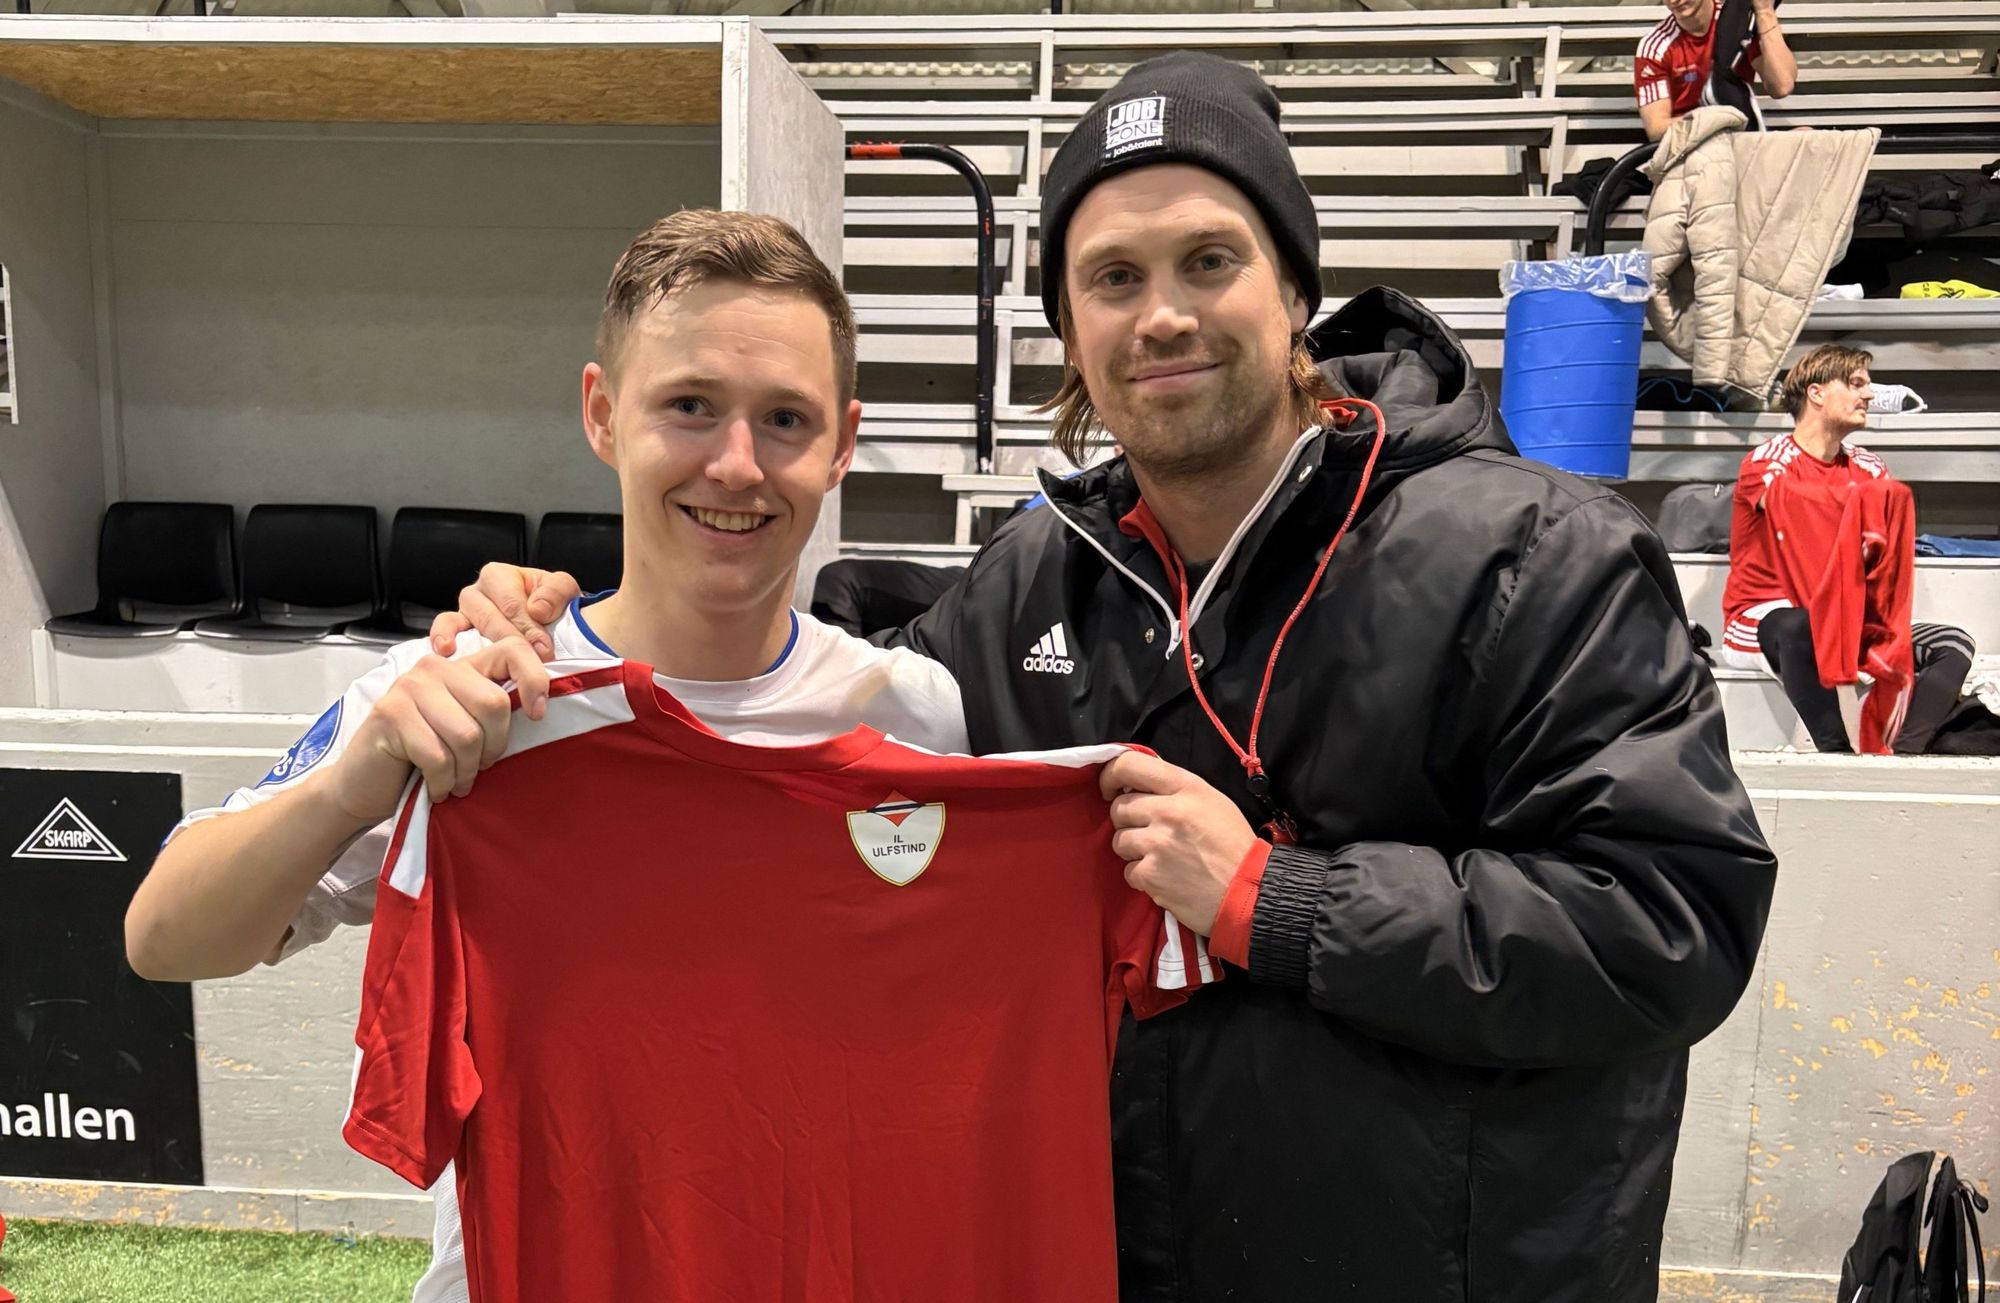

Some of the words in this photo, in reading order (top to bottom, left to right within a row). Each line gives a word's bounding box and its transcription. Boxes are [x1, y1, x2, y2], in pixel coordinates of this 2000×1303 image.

[1111, 100, 1157, 128] JOB
[1109, 121, 1159, 145] ZONE
[1022, 653, 1075, 675] adidas
[44, 829, 93, 848] SKARP
[893, 834, 905, 844] IL
[872, 842, 927, 858] ULFSTIND
